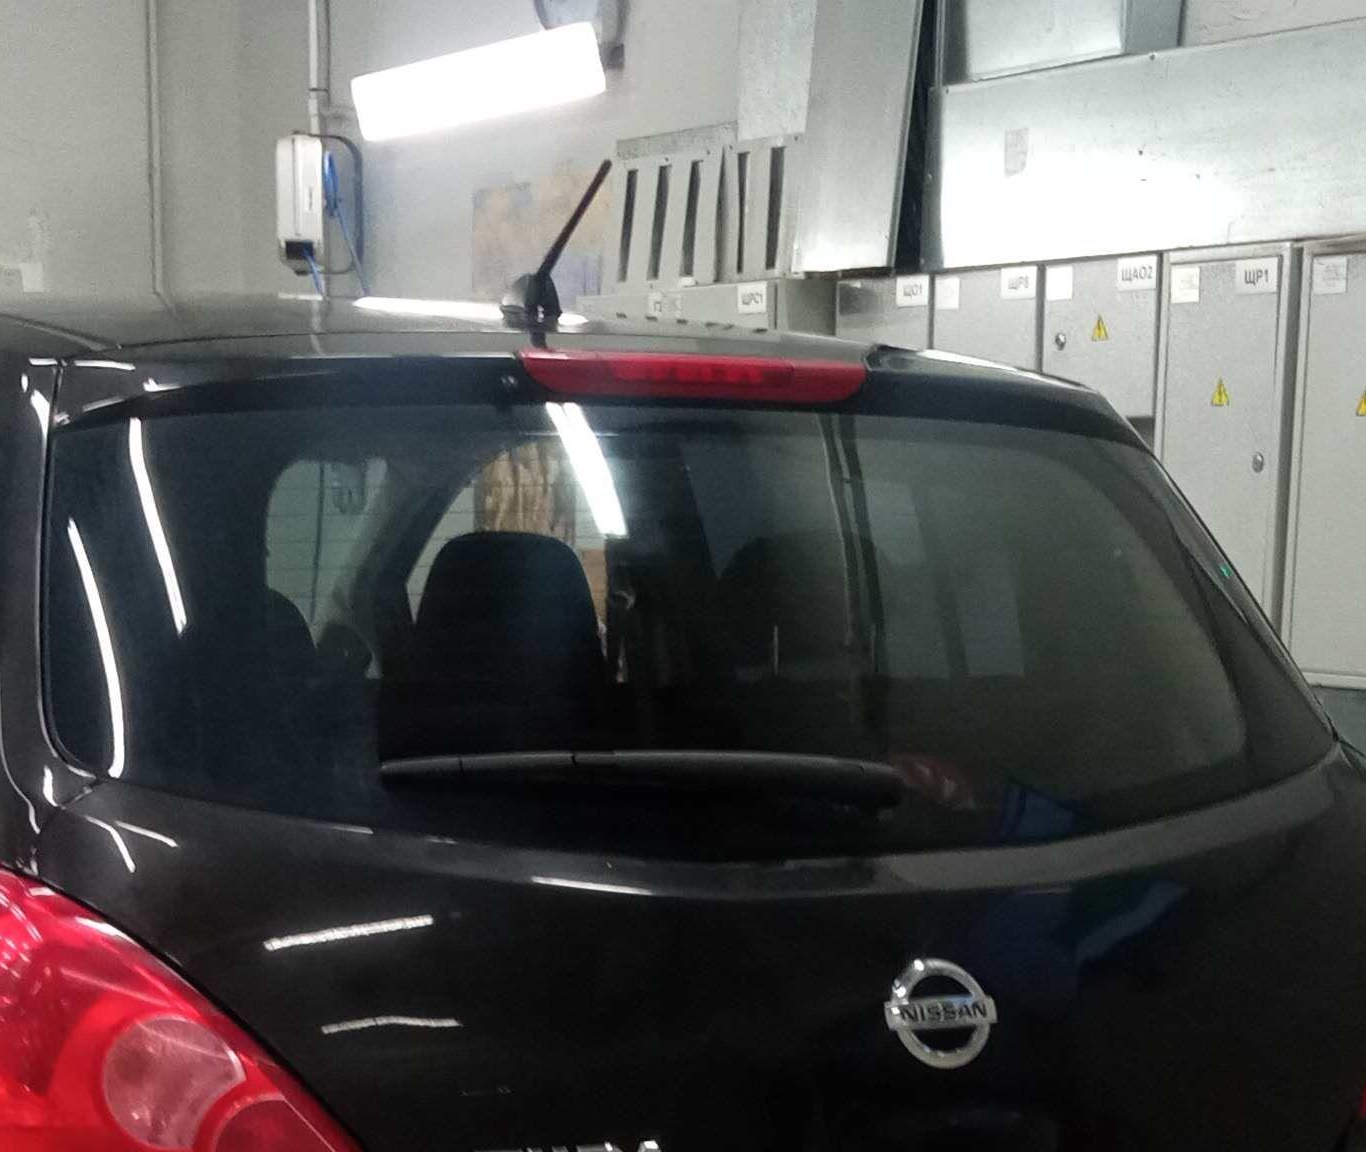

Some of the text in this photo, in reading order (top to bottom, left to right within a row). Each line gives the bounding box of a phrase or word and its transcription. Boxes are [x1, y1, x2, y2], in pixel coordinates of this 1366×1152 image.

[1121, 265, 1153, 282] ЩАО2
[1244, 269, 1269, 285] ЩР1
[899, 1002, 988, 1022] NISSAN
